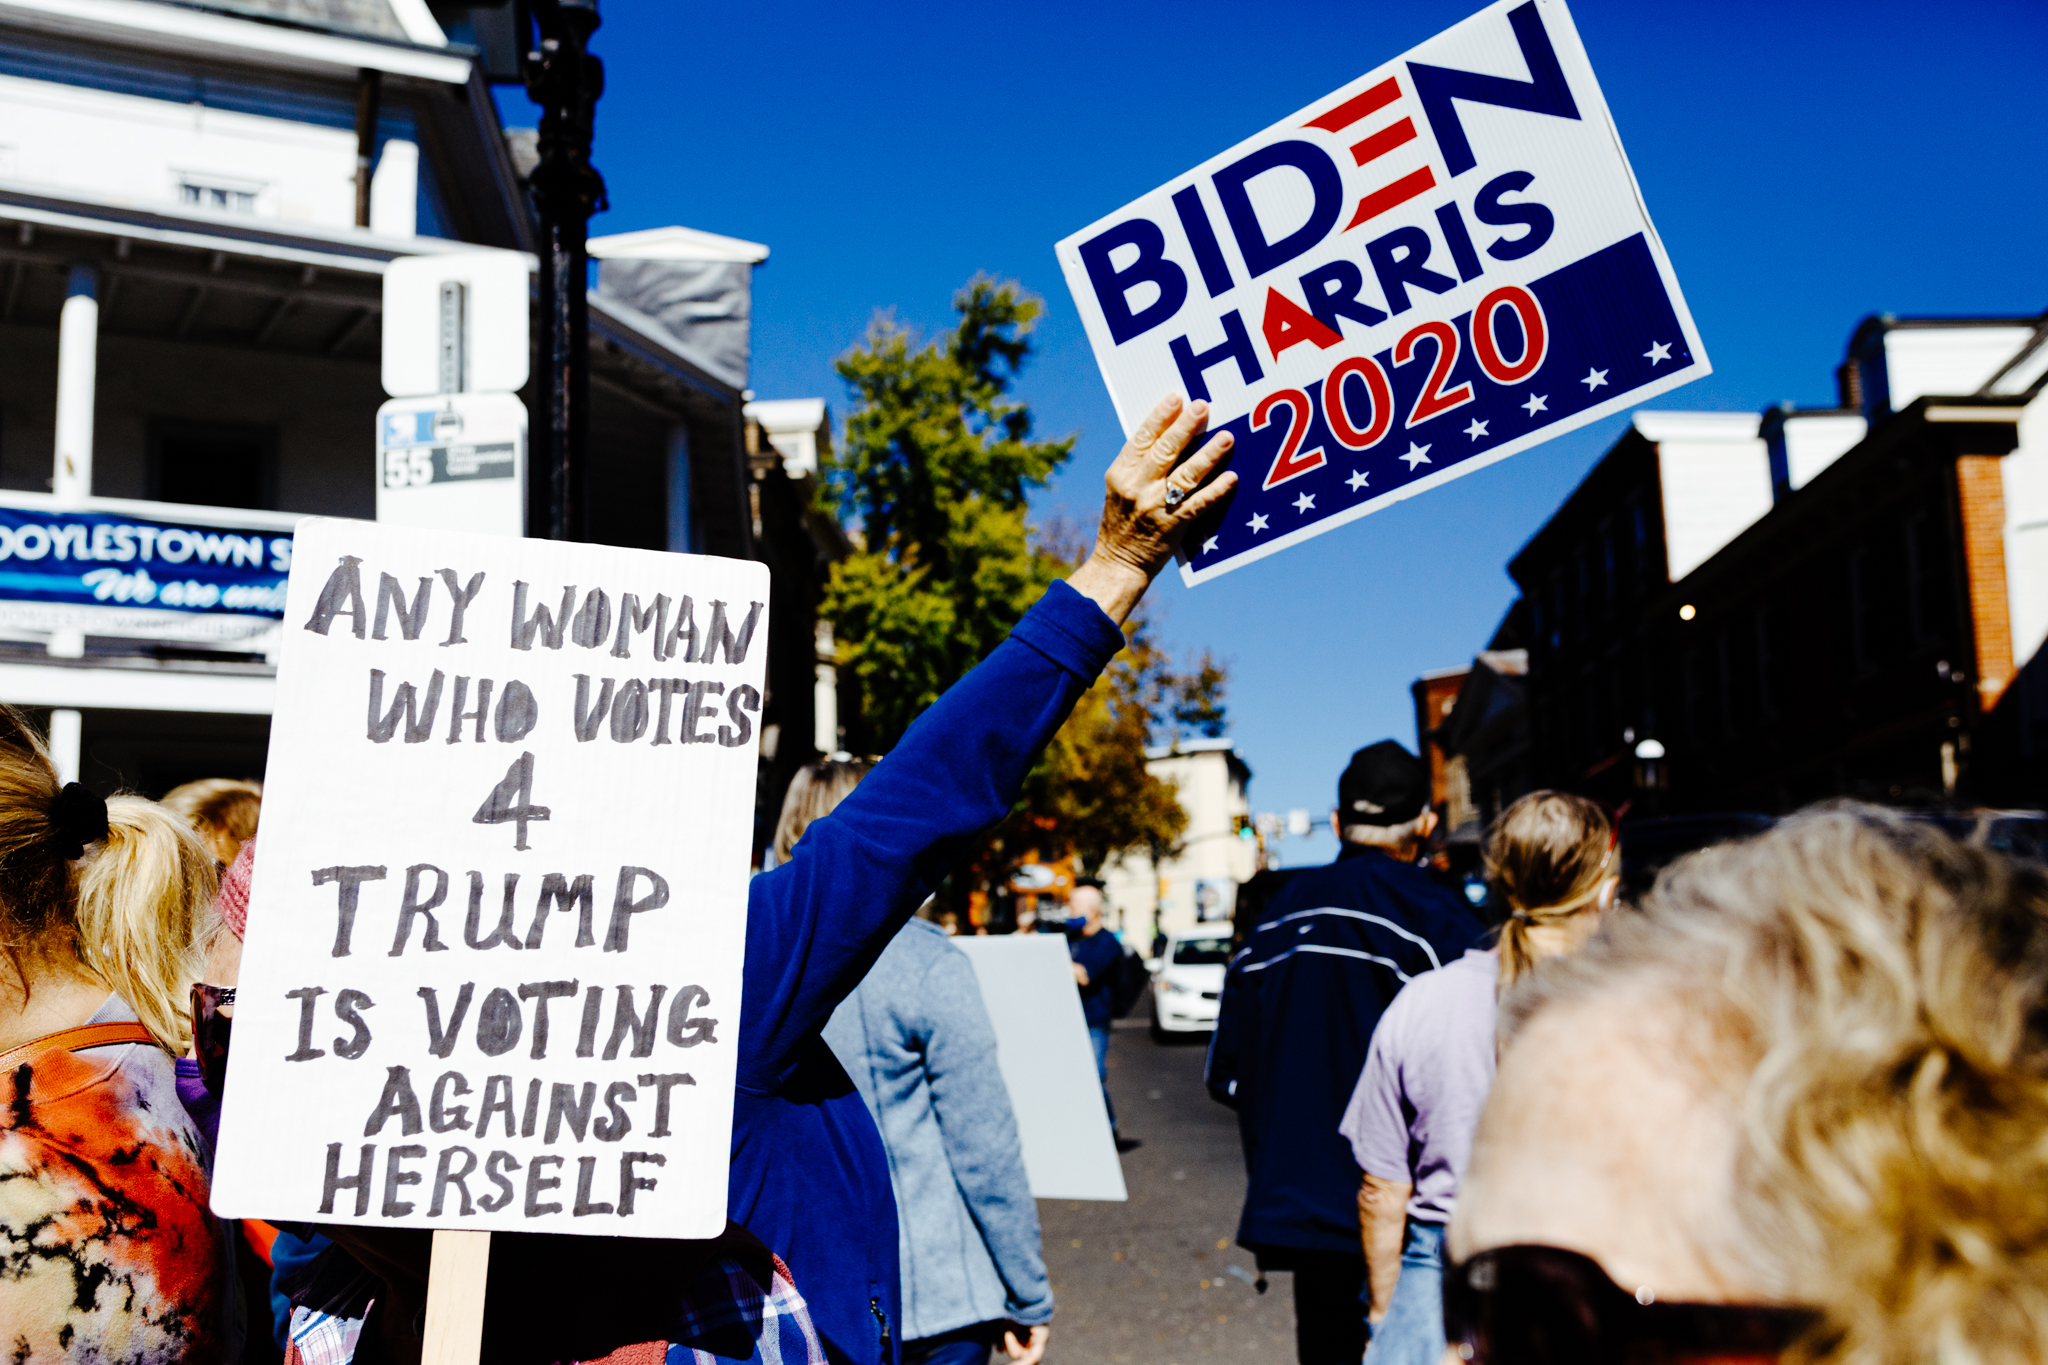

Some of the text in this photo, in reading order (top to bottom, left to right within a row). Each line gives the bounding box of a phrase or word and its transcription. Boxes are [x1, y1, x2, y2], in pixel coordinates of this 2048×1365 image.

[1078, 0, 1582, 346] BIDEN
[1169, 170, 1555, 403] HARRIS
[1249, 285, 1549, 491] 2020
[384, 447, 434, 488] 55
[304, 555, 764, 664] ANY WOMAN
[366, 668, 761, 747] WHO VOTES
[472, 751, 551, 850] 4
[311, 864, 670, 957] TRUMP
[285, 978, 719, 1062] IS VOTING
[363, 1065, 697, 1145] AGAINST
[316, 1143, 667, 1217] HERSELF
